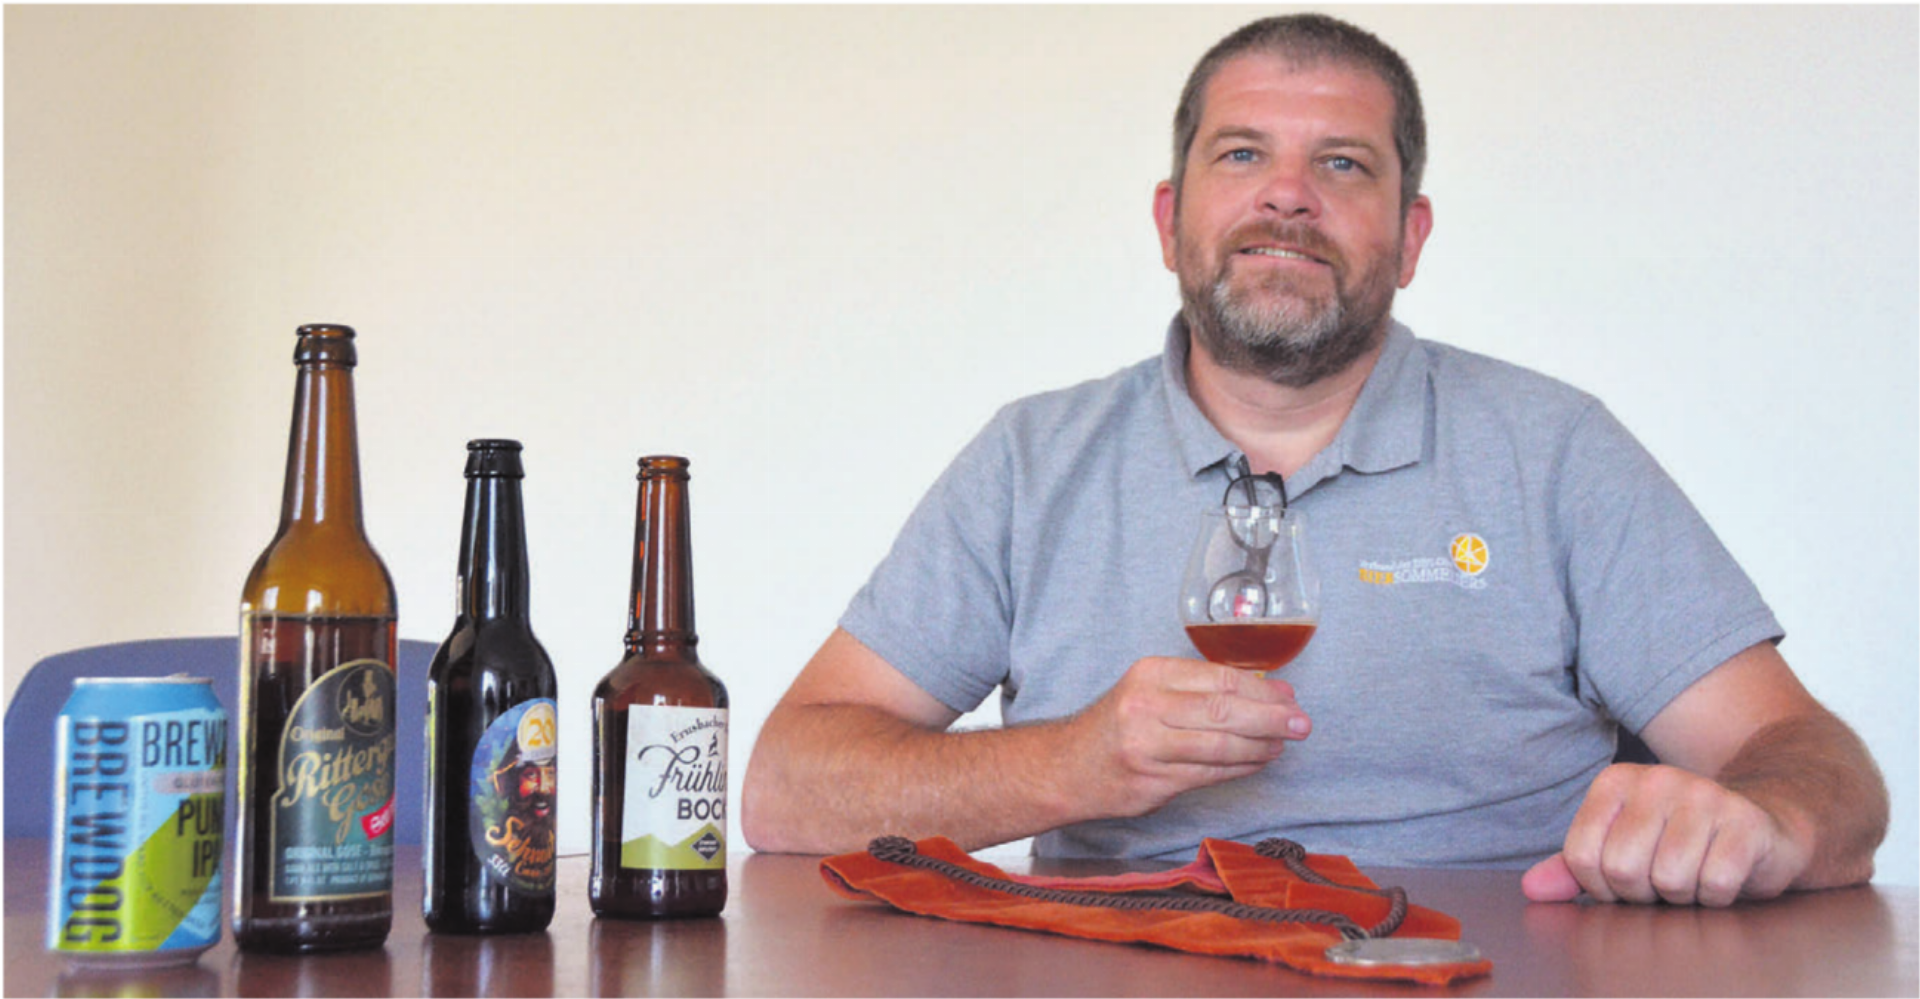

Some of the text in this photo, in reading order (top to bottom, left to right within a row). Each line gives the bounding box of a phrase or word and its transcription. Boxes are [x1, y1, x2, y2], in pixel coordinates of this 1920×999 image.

[142, 719, 228, 767] BREW
[289, 725, 345, 743] Original
[282, 736, 394, 807] Ritterg
[66, 721, 128, 943] BREWDOG
